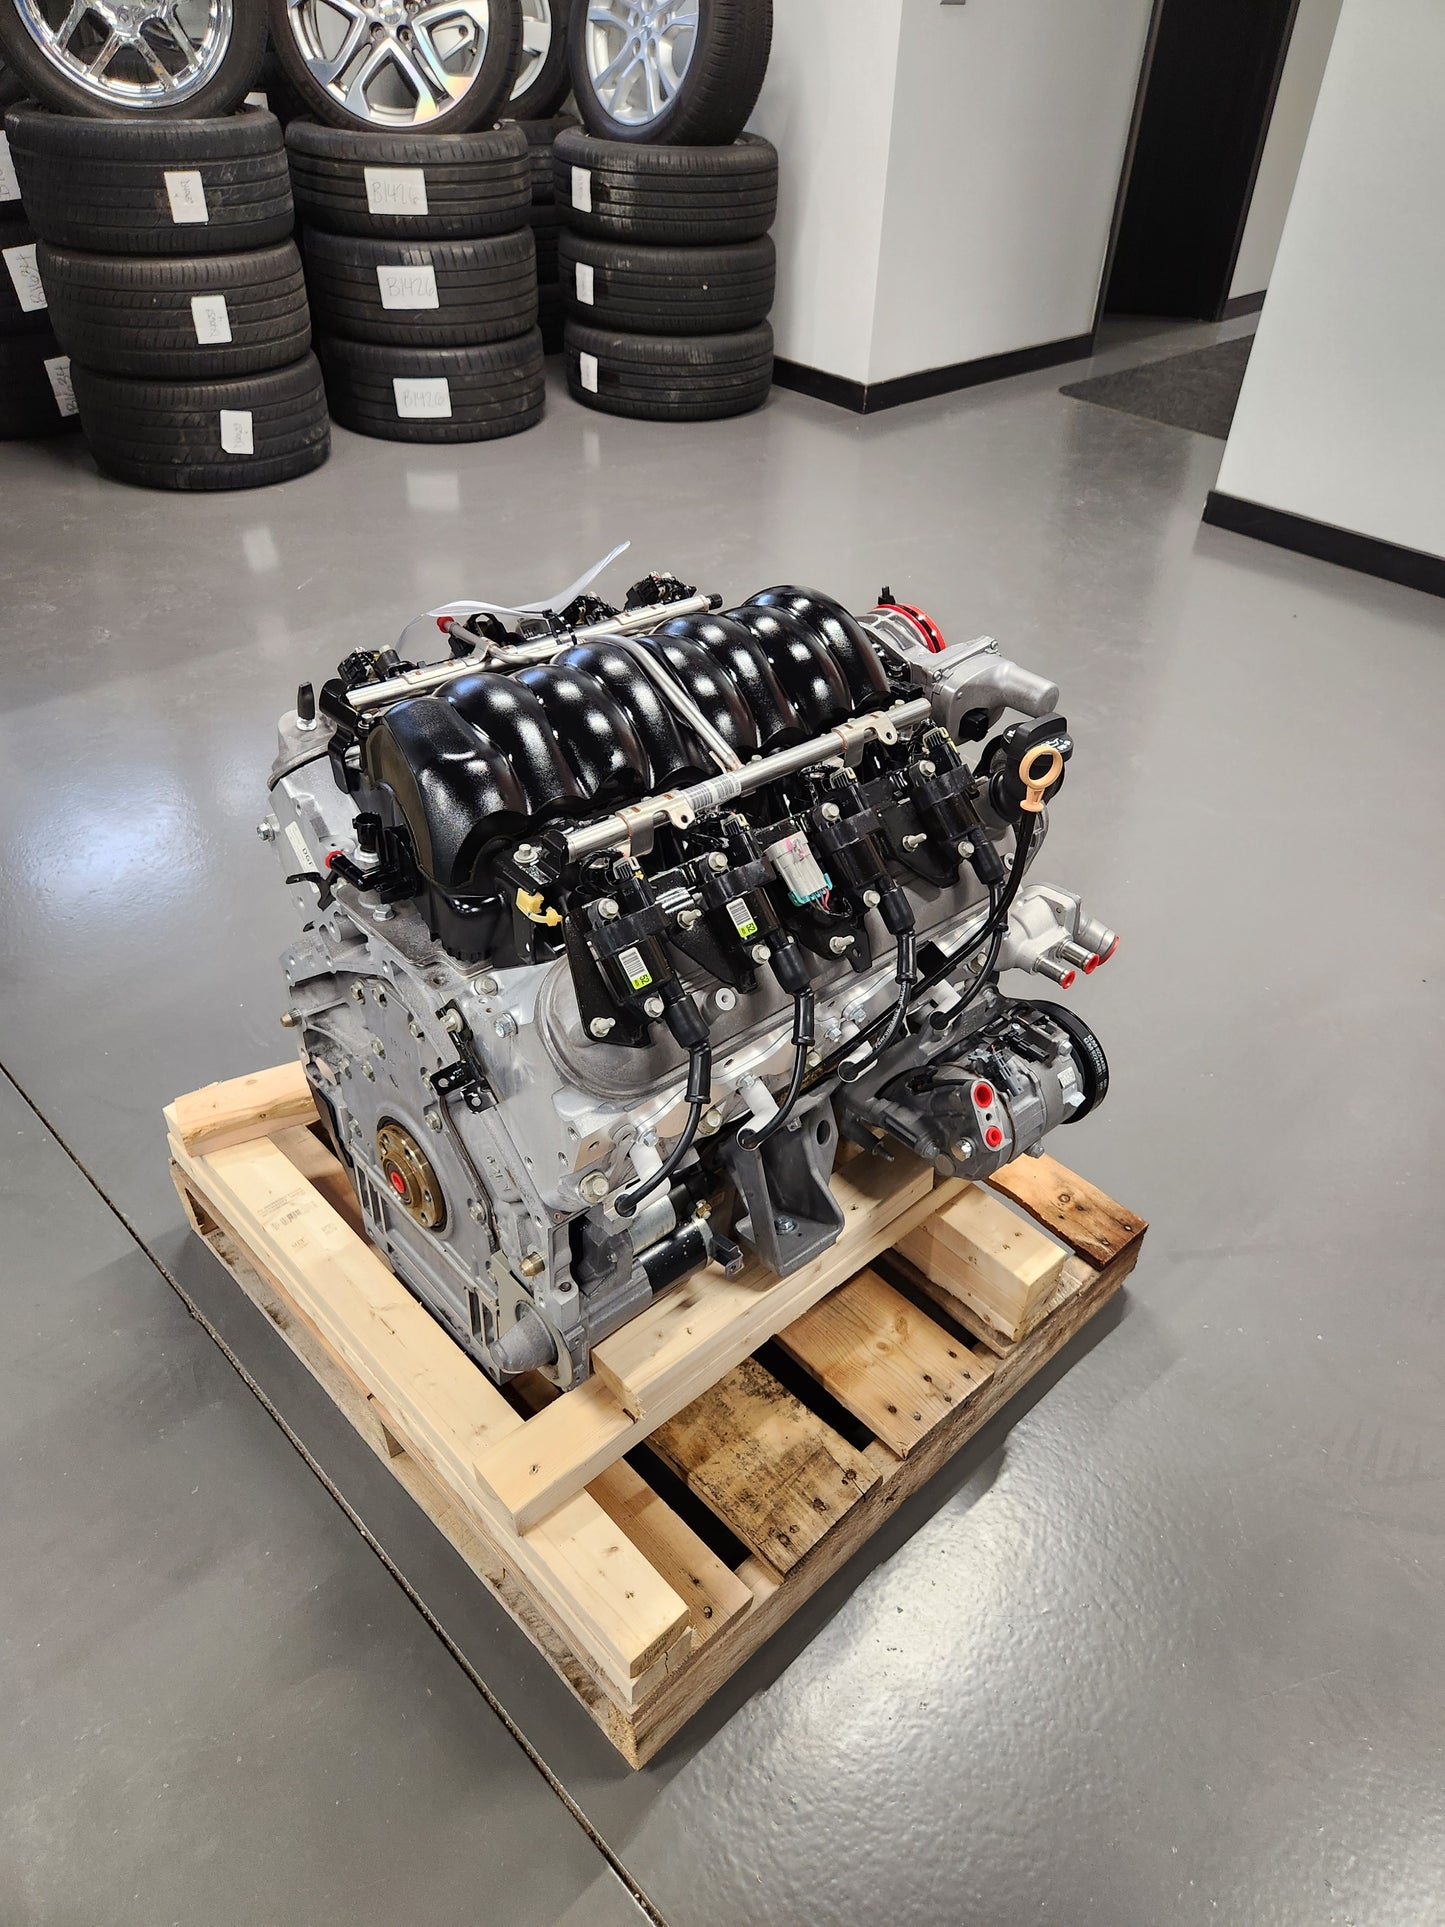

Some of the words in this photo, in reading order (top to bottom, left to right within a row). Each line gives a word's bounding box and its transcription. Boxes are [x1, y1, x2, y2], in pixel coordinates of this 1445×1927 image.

[372, 180, 419, 205] B1426
[386, 276, 436, 298] B1426
[403, 390, 446, 409] B1426
[746, 922, 756, 933] 52
[640, 974, 650, 985] 52
